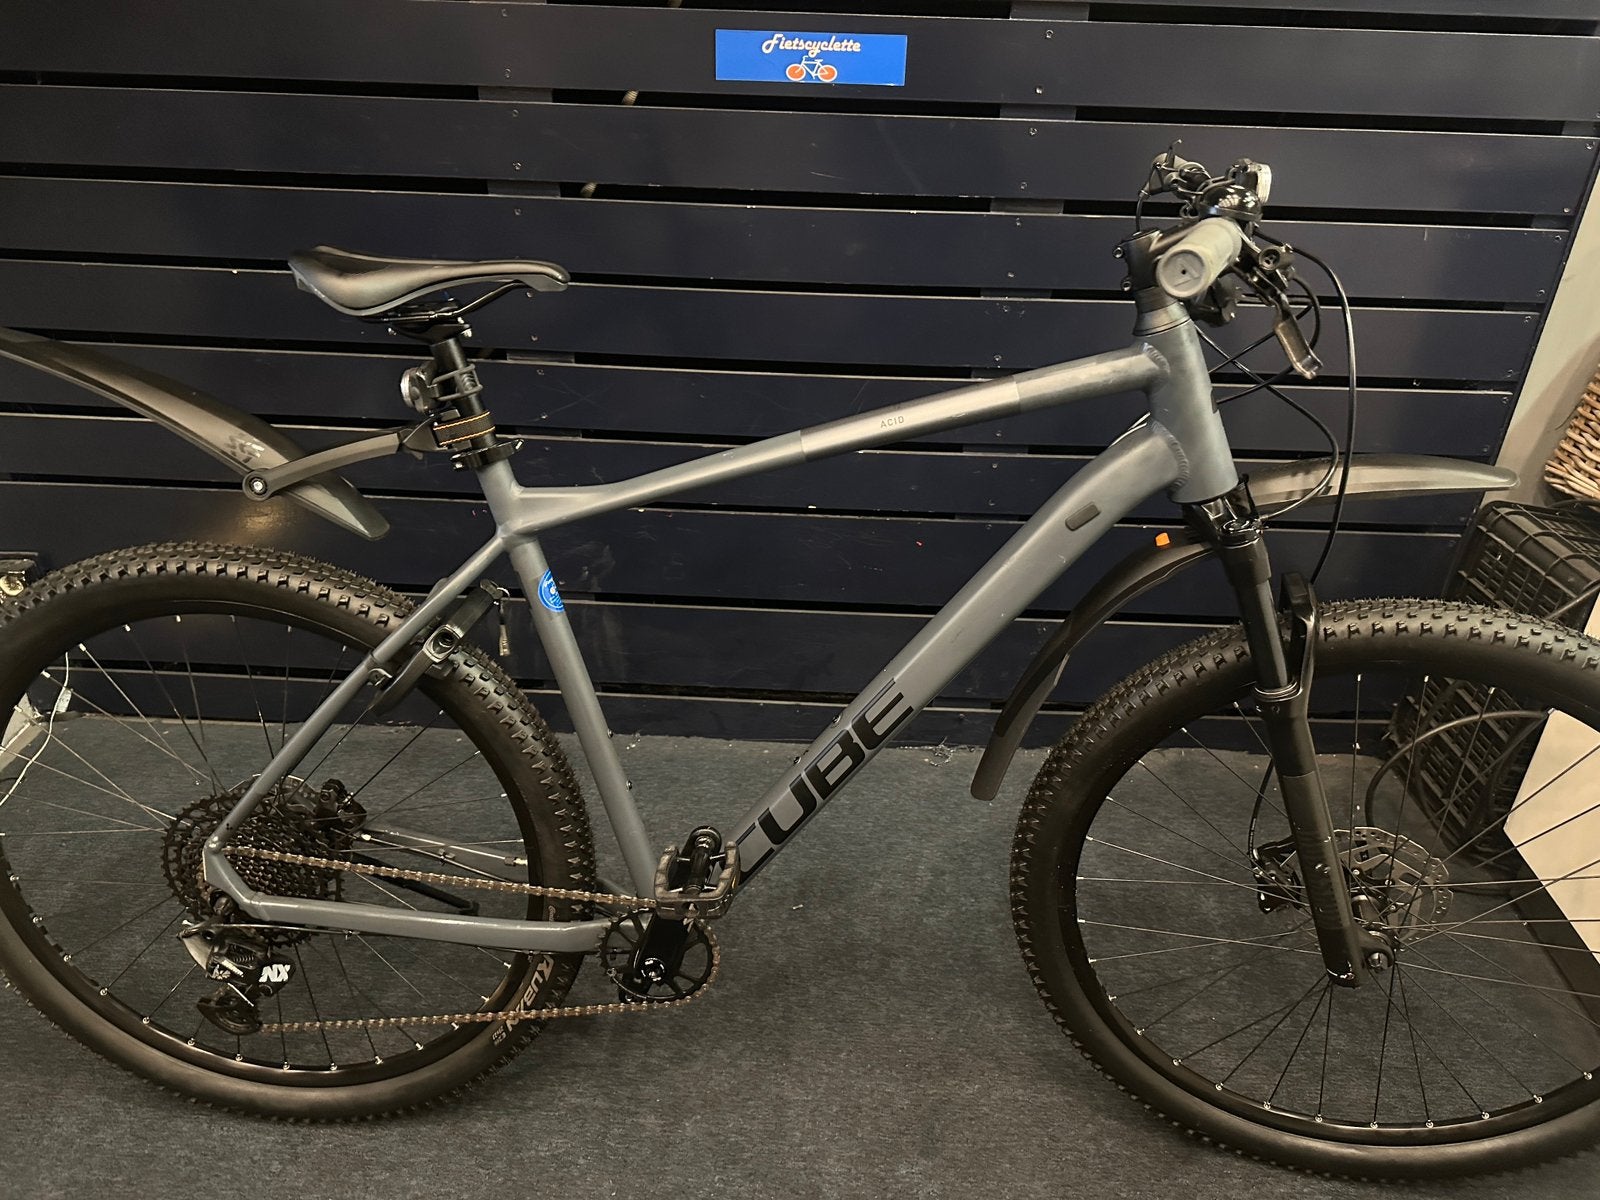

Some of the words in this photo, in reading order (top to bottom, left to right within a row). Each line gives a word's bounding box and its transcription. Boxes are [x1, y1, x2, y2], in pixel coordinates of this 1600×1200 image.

[762, 34, 861, 57] Fietscyclette
[880, 416, 904, 428] ACID
[735, 678, 914, 885] CUBE
[259, 964, 290, 982] NX
